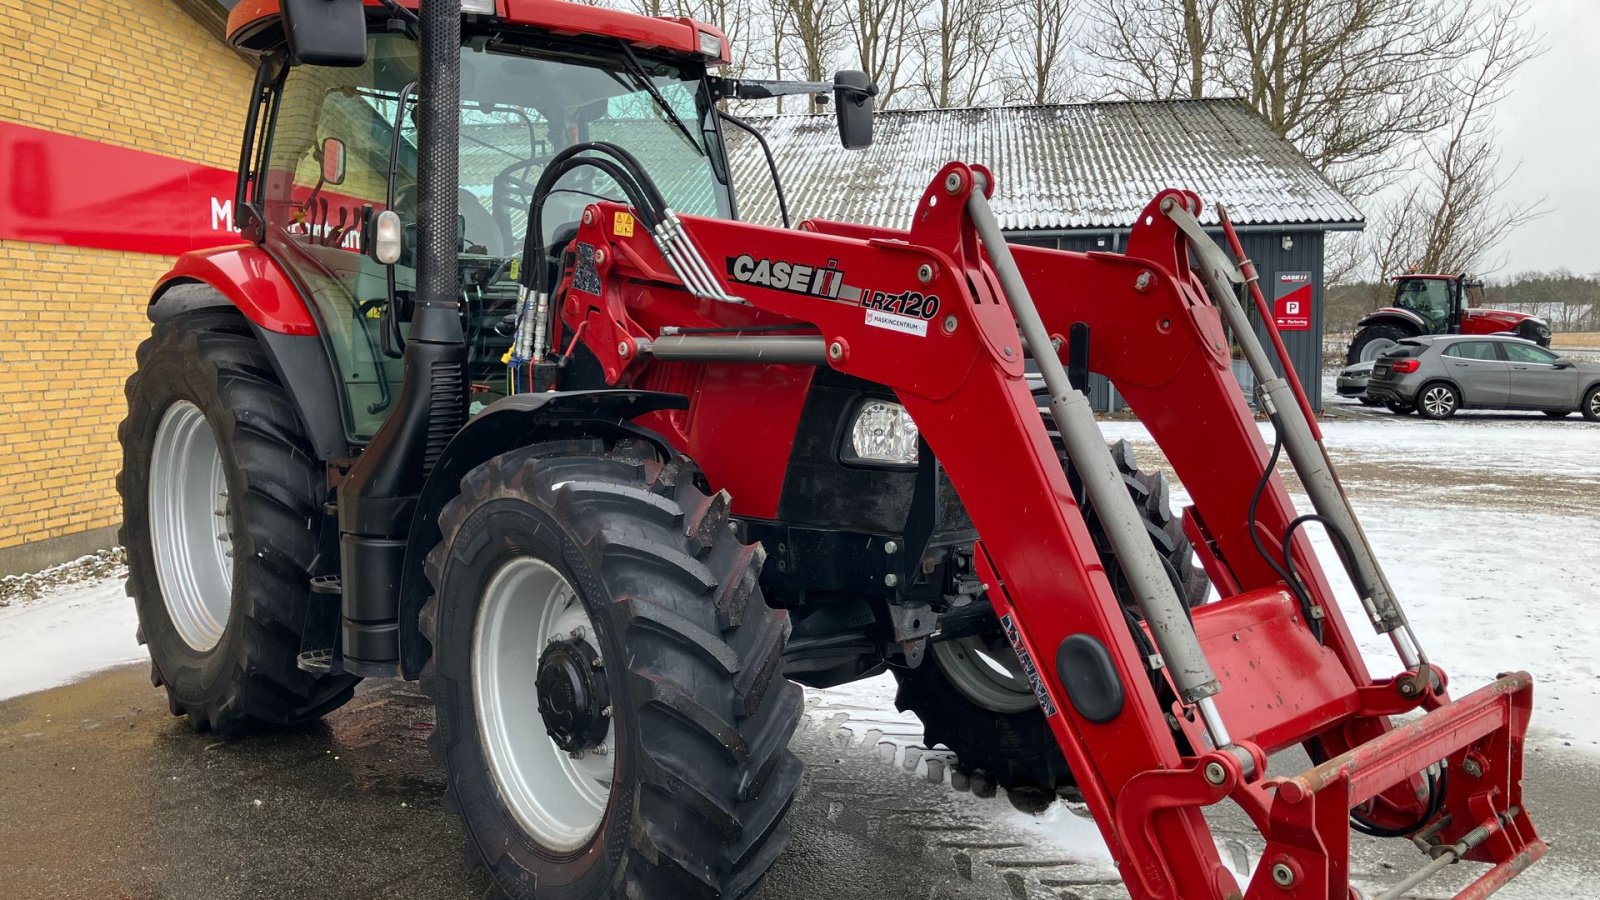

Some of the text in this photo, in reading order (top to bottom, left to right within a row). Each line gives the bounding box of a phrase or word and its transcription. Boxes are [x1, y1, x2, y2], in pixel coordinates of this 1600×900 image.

[733, 254, 812, 293] CASE
[860, 289, 941, 320] LRZ120
[874, 315, 918, 330] MASKINCENTRUM
